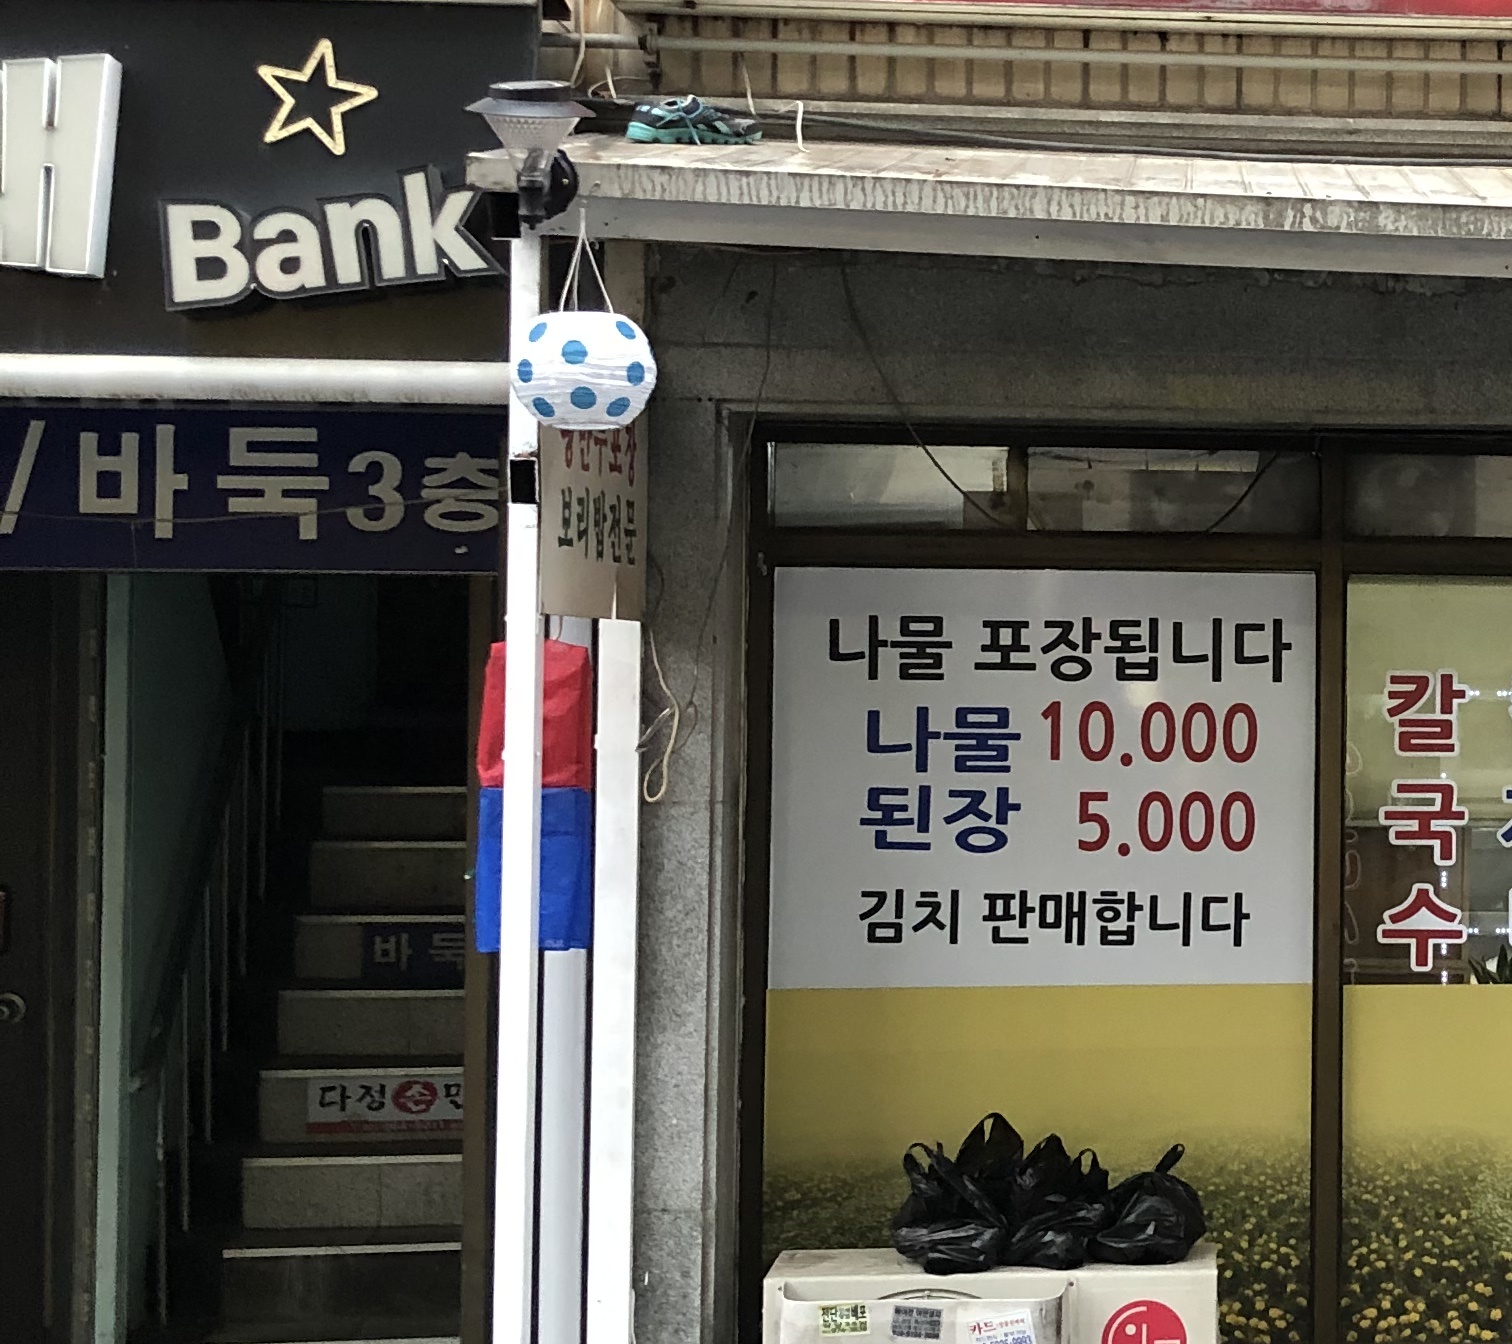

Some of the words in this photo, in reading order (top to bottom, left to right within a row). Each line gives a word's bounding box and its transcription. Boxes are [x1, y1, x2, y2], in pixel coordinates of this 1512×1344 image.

[166, 170, 488, 303] Bank
[828, 614, 953, 680] 나물
[974, 615, 1292, 683] 포장됩니다
[866, 706, 1022, 773] 나물
[1040, 700, 1258, 767] 10.000
[859, 785, 1022, 854] 된장
[1077, 791, 1256, 857] 5.000
[1380, 672, 1468, 968] 칼국수
[859, 889, 959, 945] 김치
[981, 890, 1251, 947] 판매합니다
